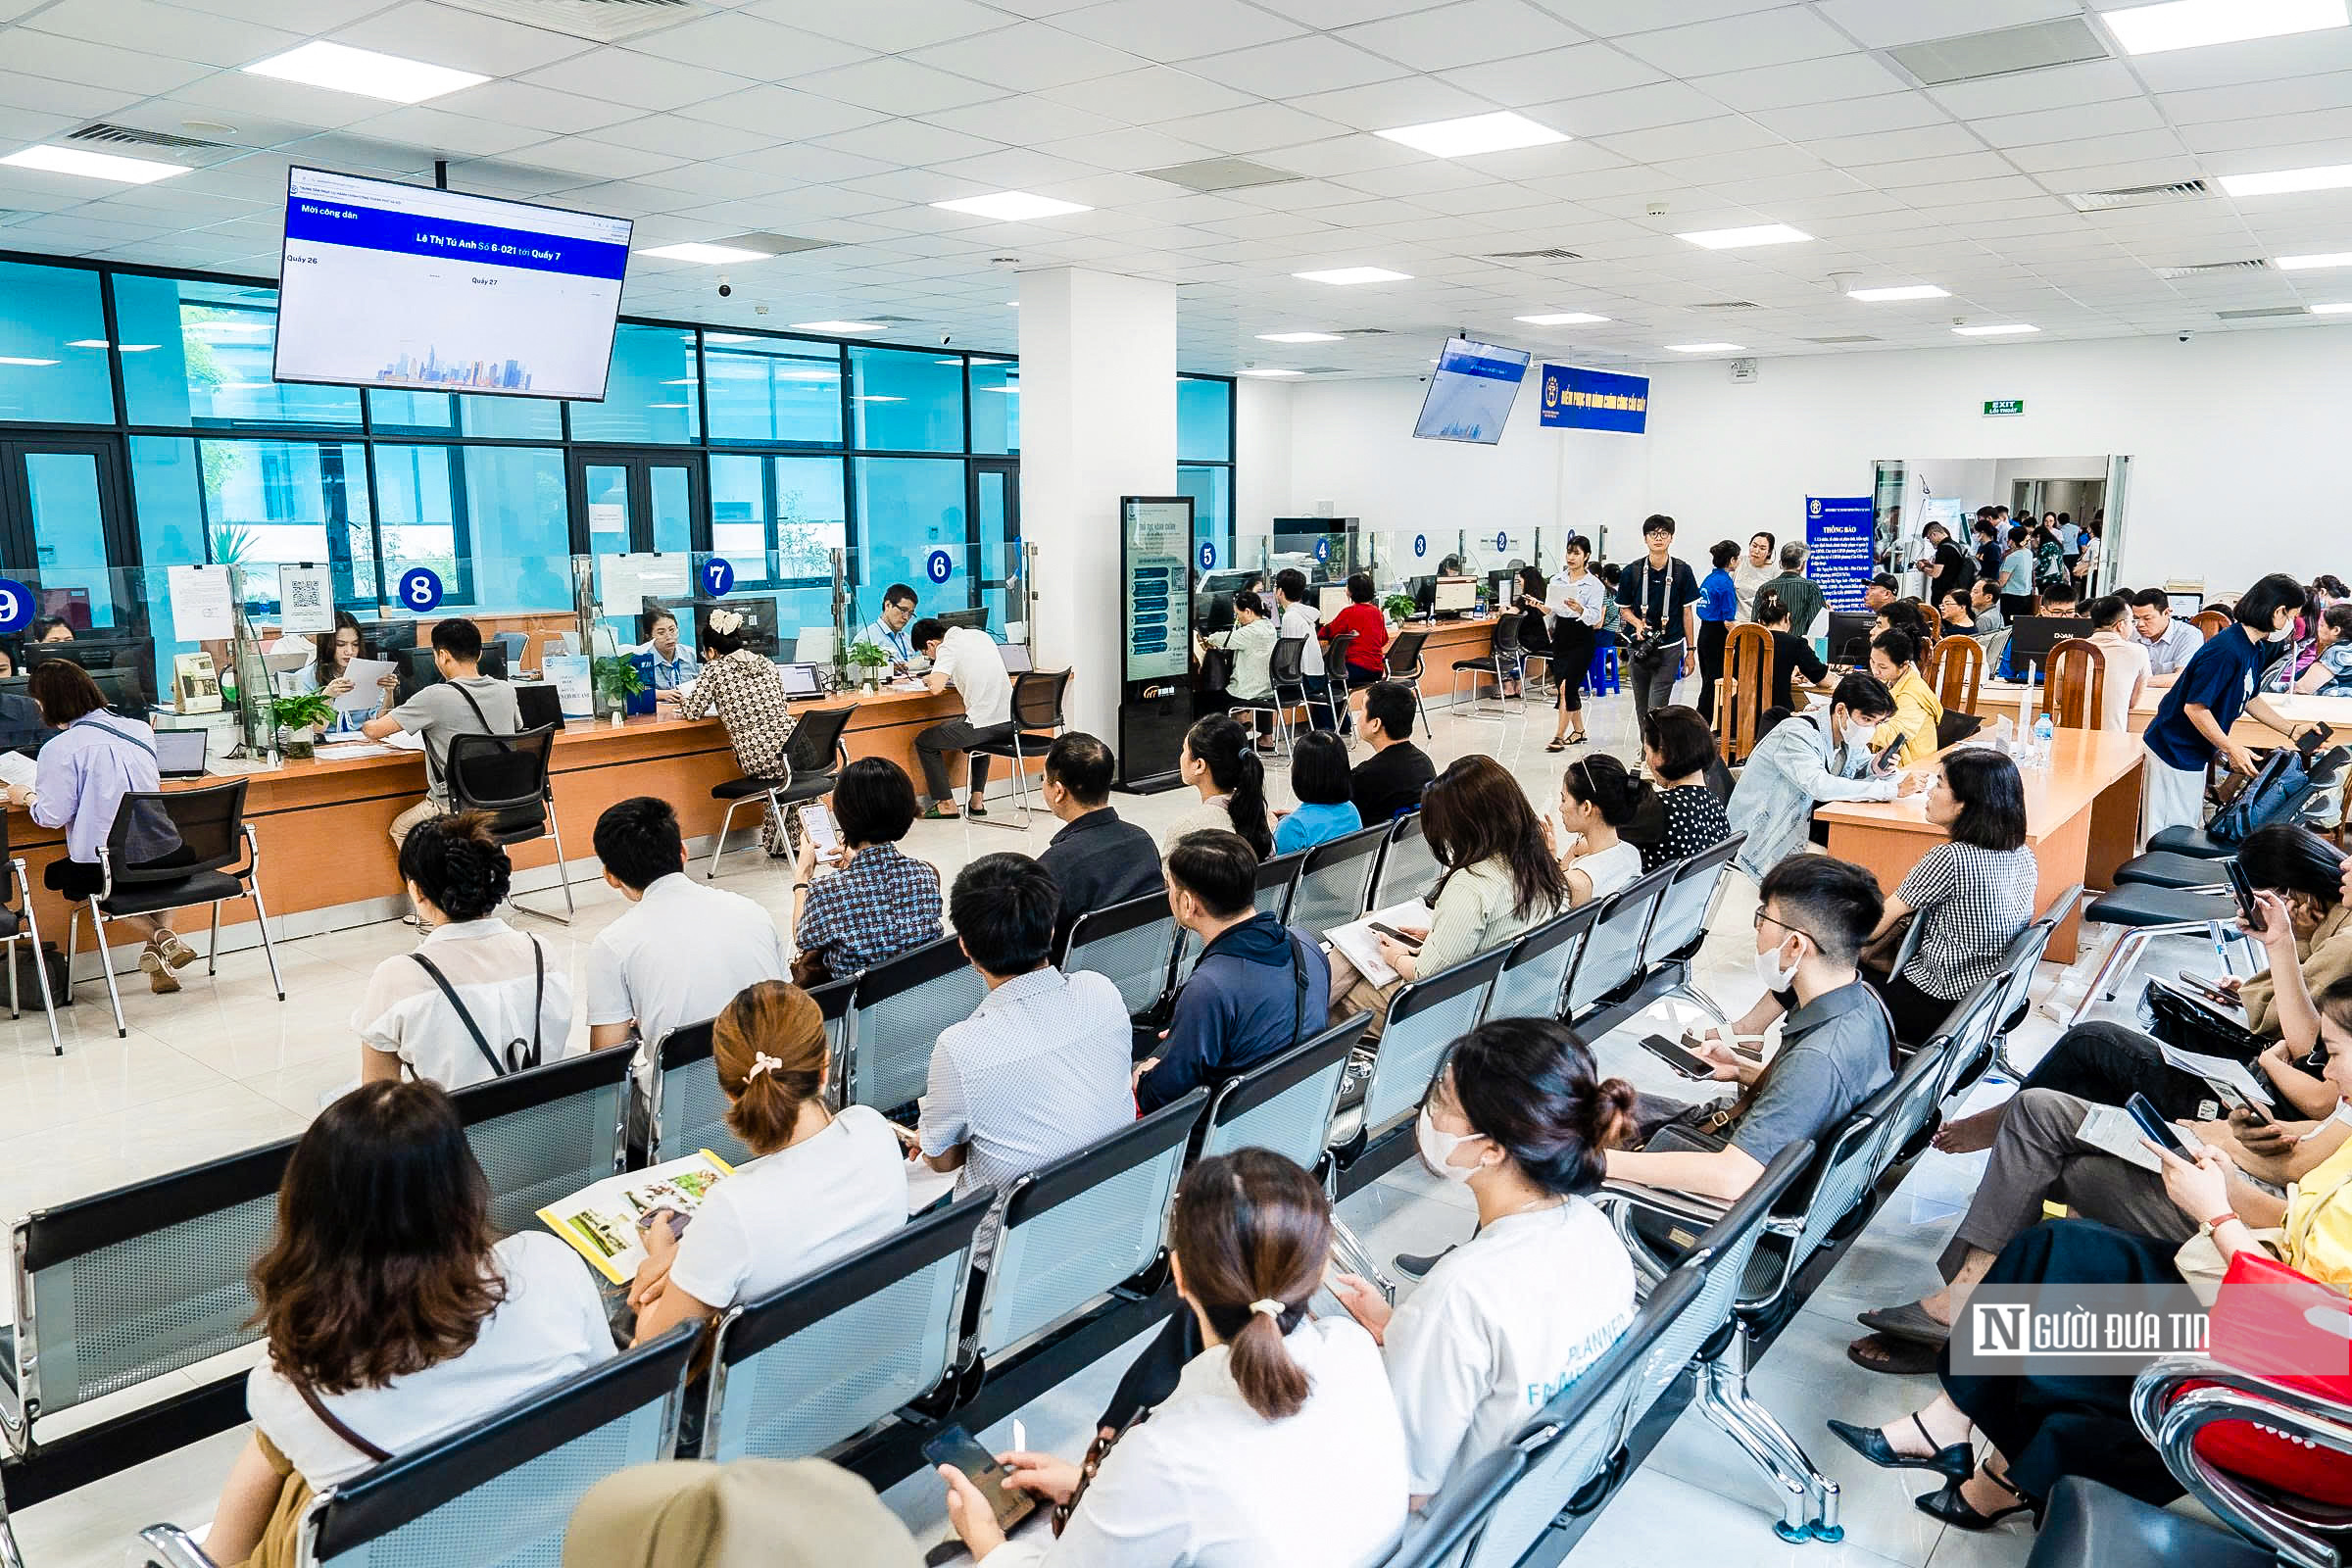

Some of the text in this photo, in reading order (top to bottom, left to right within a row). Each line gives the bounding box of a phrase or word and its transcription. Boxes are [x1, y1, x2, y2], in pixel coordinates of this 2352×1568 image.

[301, 204, 359, 220] Mời công dân
[430, 234, 445, 247] Thị
[446, 236, 458, 246] Tú
[459, 239, 477, 249] Anh
[491, 243, 516, 255] 6-021
[555, 252, 562, 261] 7
[1318, 542, 1327, 559] 4
[1417, 539, 1424, 554] 3
[1498, 534, 1505, 549] 2
[1203, 547, 1212, 565] 5
[710, 565, 725, 589] 7
[932, 556, 947, 579] 6
[411, 575, 432, 604] 8
[0, 589, 19, 622] 9
